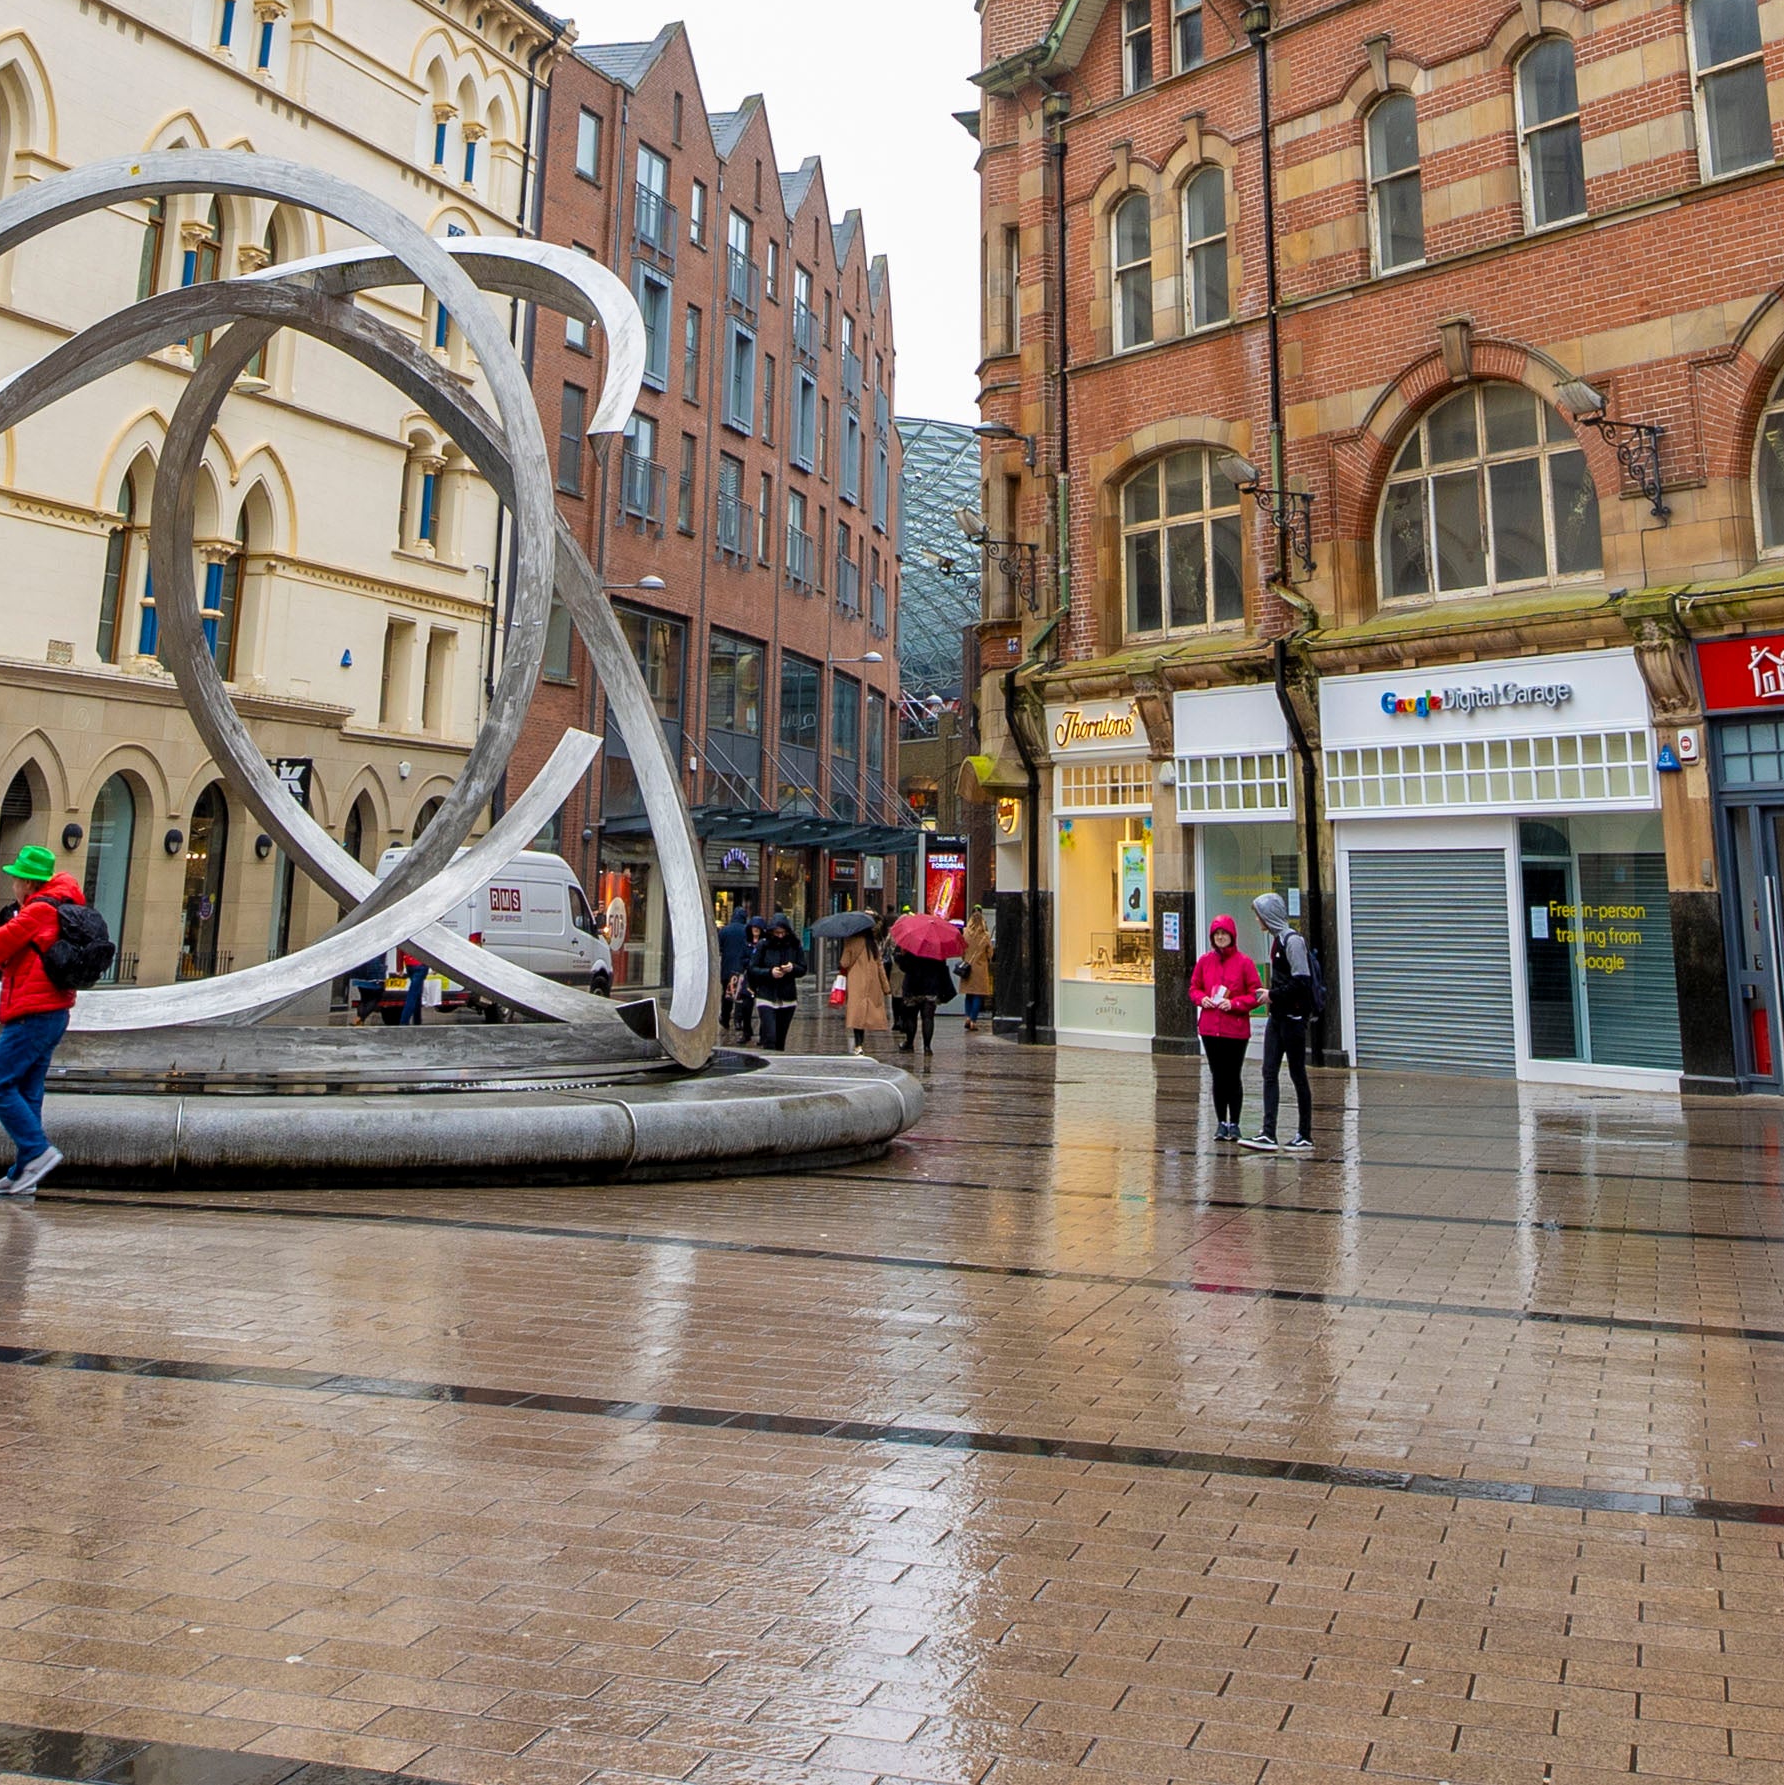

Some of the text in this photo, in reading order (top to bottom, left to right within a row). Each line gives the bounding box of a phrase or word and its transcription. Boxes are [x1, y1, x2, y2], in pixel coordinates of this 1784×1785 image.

[1381, 681, 1572, 718] Google Digital Garage
[1055, 711, 1134, 747] Thorntons
[491, 889, 520, 910] RMS
[1549, 900, 1577, 918] Free
[1609, 927, 1642, 944] from
[1575, 953, 1625, 974] Google
